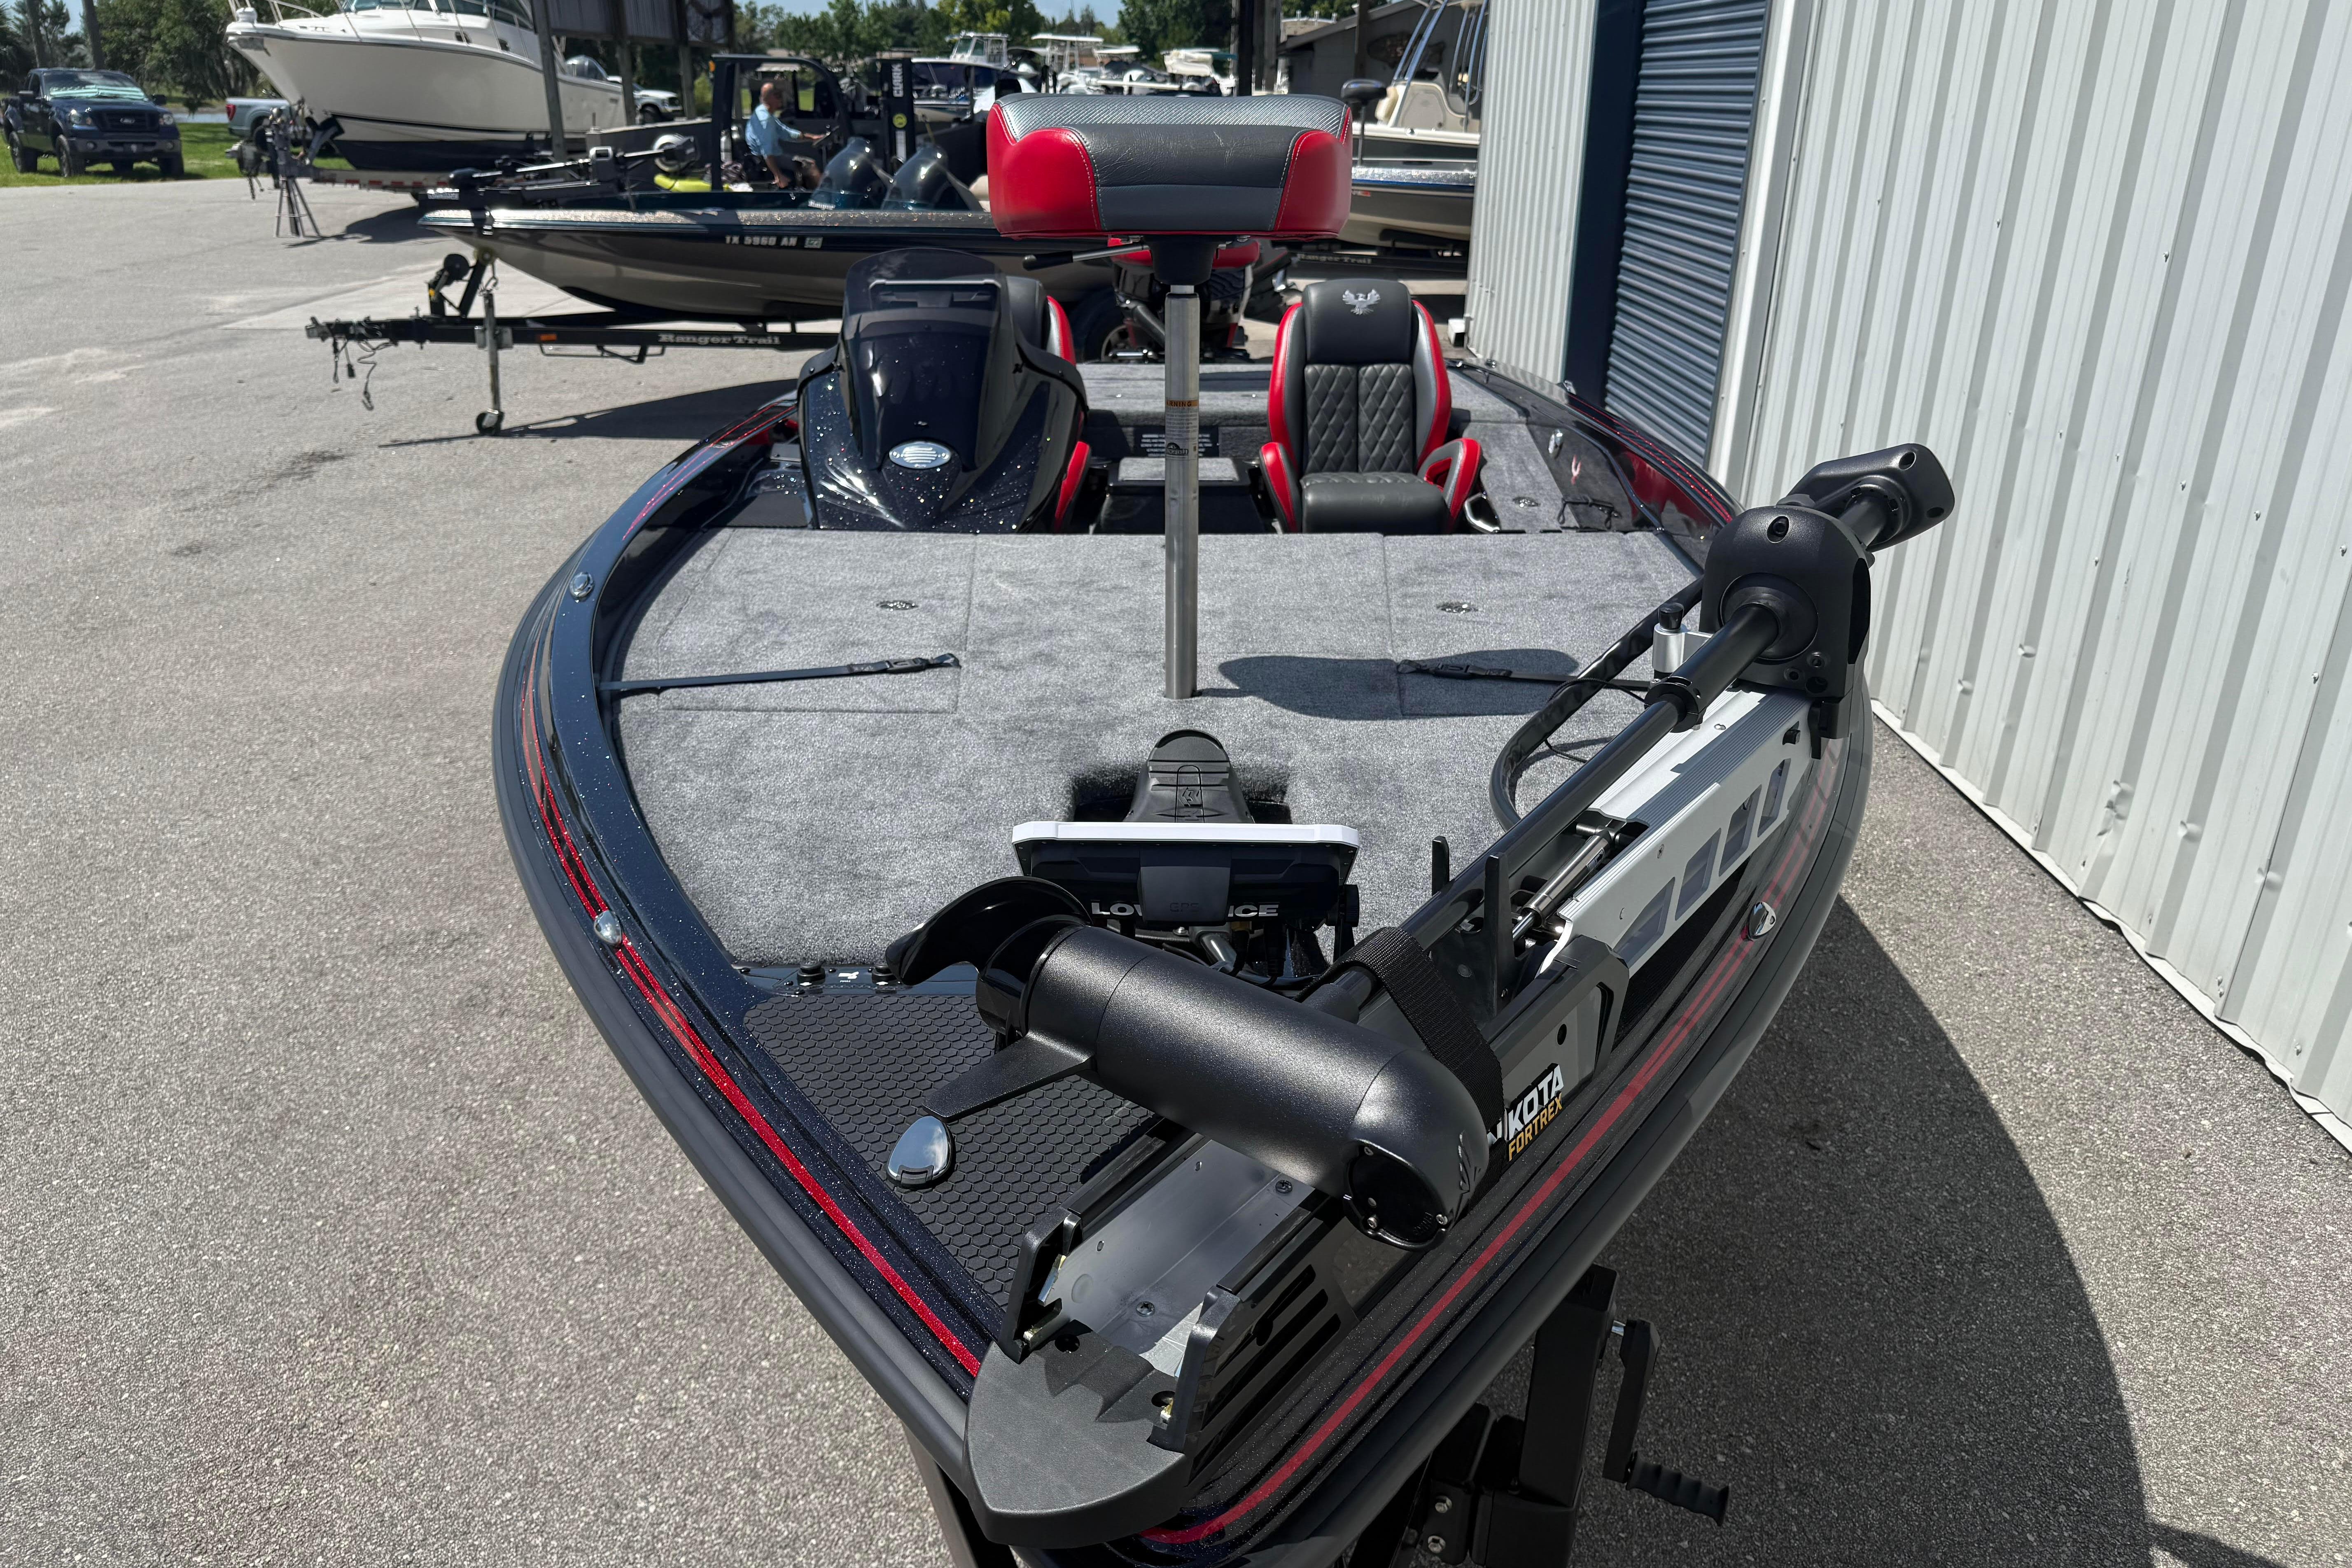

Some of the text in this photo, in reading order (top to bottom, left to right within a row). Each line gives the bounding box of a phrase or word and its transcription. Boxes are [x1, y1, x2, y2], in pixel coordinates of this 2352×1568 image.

[891, 63, 903, 97] CLARK
[659, 334, 781, 345] Ranger Trail
[1169, 903, 1199, 913] GPS
[1508, 1064, 1564, 1141] KOTA
[1509, 1092, 1562, 1162] FORTREX
